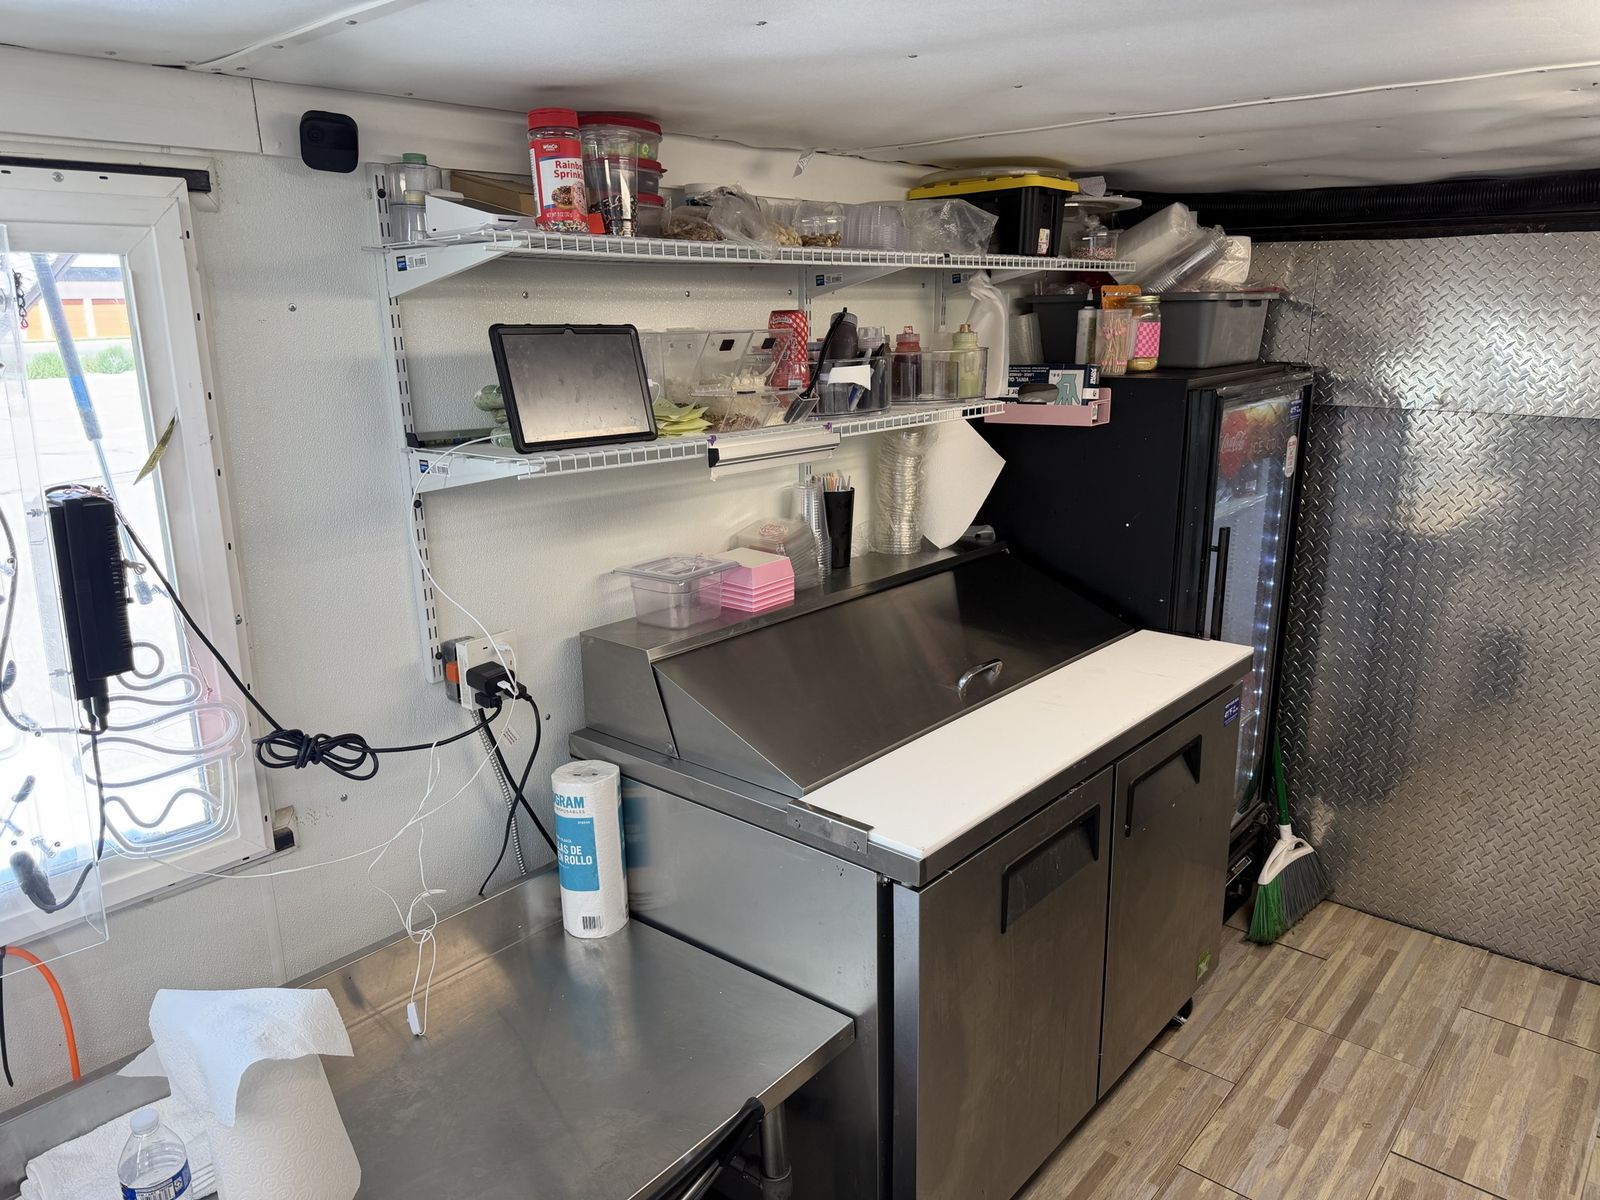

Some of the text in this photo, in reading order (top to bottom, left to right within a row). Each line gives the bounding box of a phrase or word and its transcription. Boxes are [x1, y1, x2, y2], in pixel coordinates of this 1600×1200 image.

[555, 160, 582, 170] Rainbo
[553, 793, 584, 808] GRAM
[571, 846, 582, 855] DE
[564, 855, 592, 865] ROLLO
